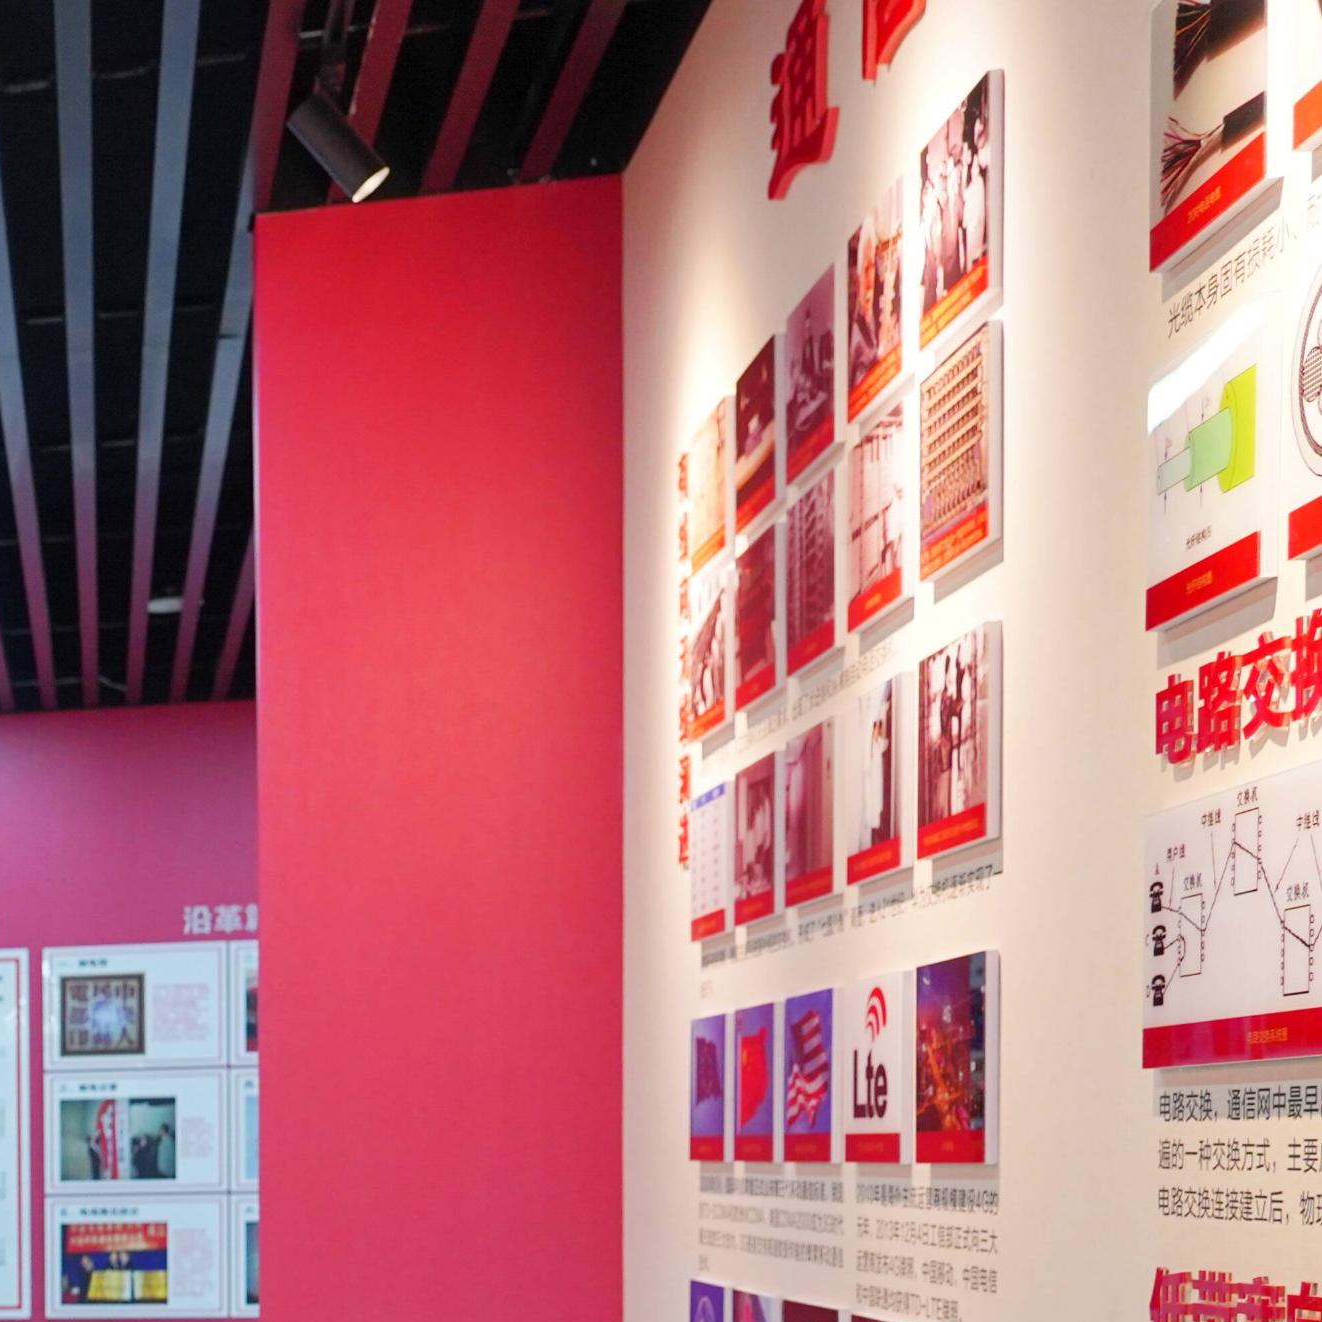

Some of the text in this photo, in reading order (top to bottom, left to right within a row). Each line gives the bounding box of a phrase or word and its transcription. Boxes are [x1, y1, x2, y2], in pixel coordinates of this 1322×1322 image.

[853, 1048, 887, 1118] Lte
[1159, 1084, 1322, 1122] 电路交换，通信网中最早
[1158, 1137, 1322, 1173] 遍的一种交换方式，主要
